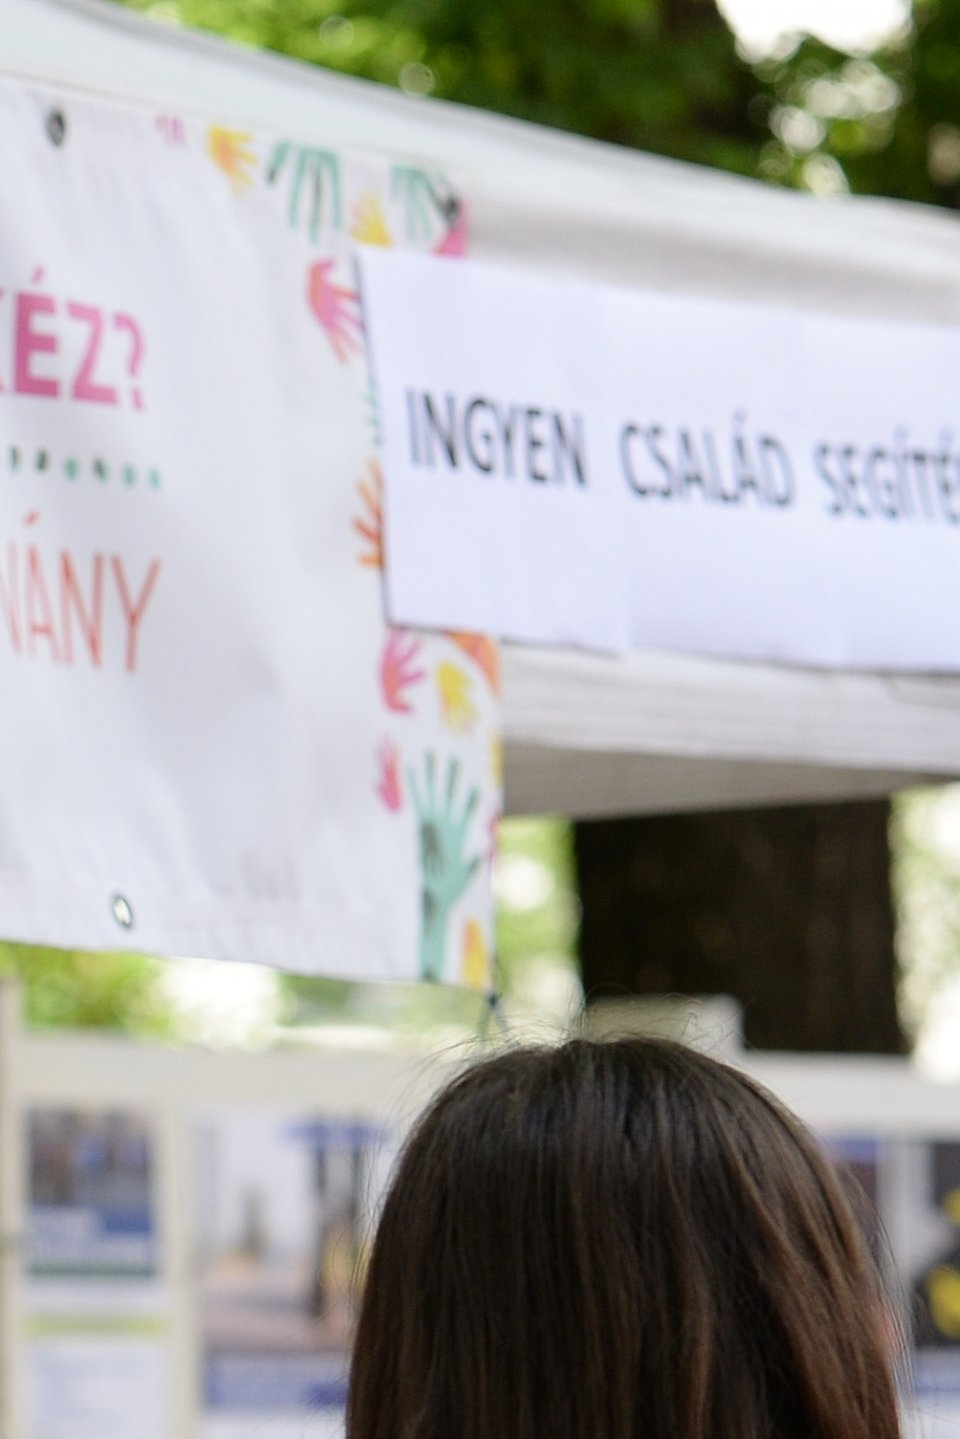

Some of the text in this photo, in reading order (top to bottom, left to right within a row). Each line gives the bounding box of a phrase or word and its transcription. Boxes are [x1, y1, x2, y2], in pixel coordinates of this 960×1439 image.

[406, 388, 960, 527] INGYEN CSALÁD SEGÍTÉ
